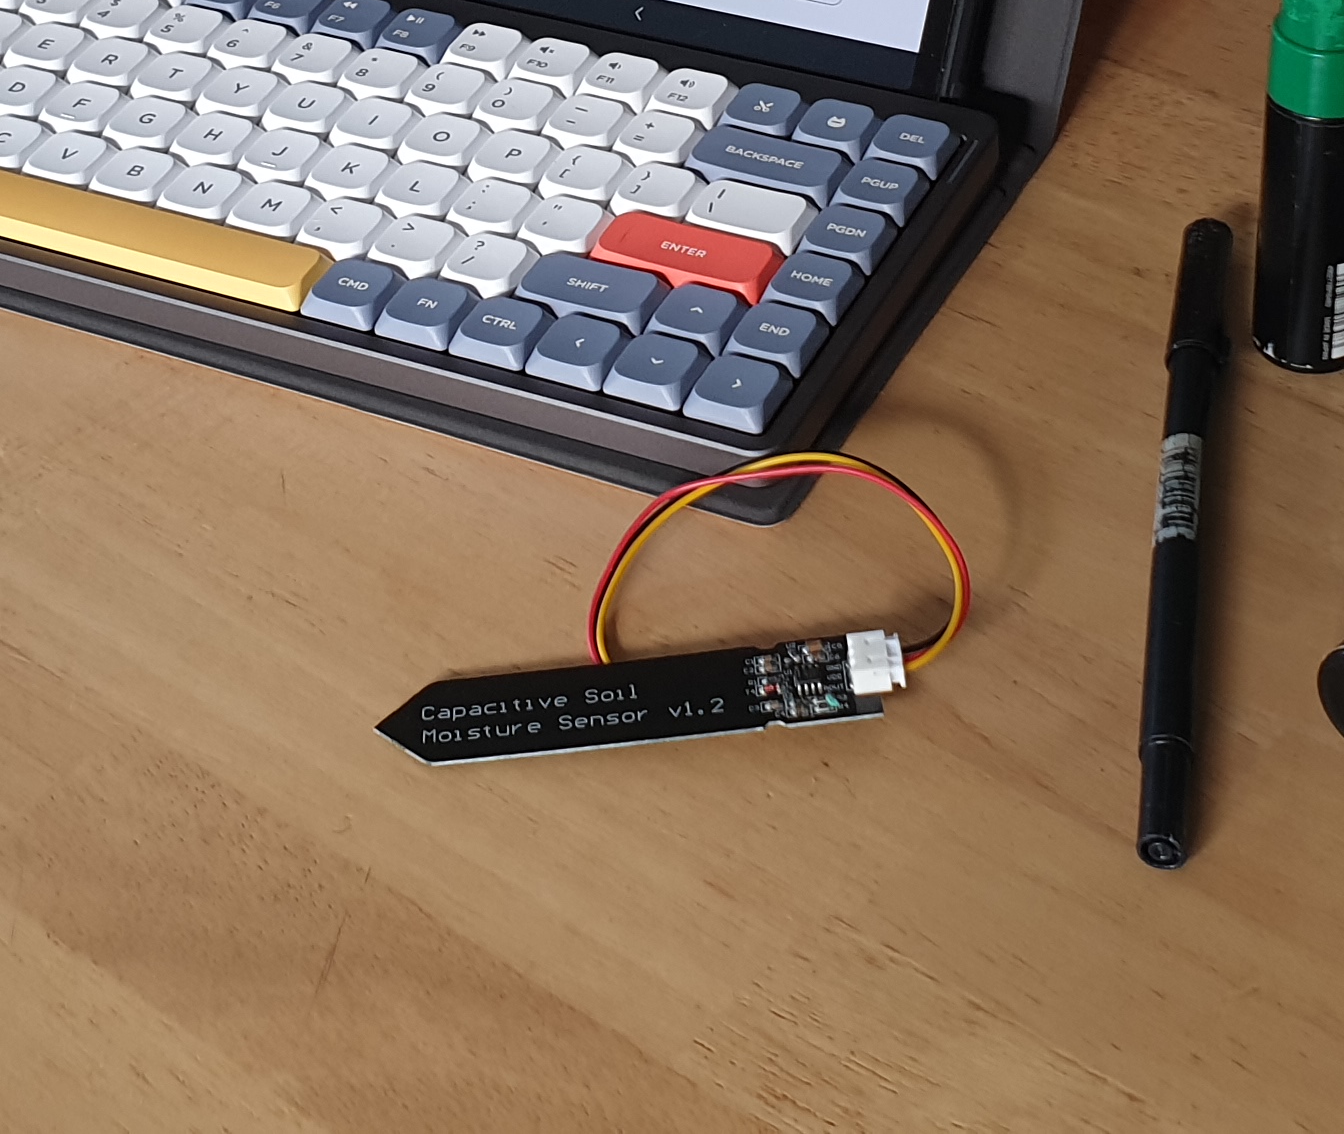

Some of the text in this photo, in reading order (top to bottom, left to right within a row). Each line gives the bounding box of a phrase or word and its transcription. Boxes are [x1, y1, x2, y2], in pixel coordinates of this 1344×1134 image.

[264, 1, 281, 9] F6
[173, 13, 185, 22] %
[160, 25, 174, 33] 5
[37, 39, 55, 49] E
[226, 40, 239, 48] 6
[101, 54, 118, 65] R
[291, 53, 304, 61] 7
[527, 59, 548, 68] F10
[169, 68, 183, 78] T
[355, 68, 369, 77] 8
[596, 75, 615, 84] F11
[8, 82, 26, 92] D
[234, 83, 249, 94] Y
[422, 84, 436, 92] 9
[72, 98, 91, 108] F
[667, 93, 688, 102] F12
[298, 98, 315, 109] U
[139, 113, 156, 124] G
[368, 115, 378, 125] I
[203, 129, 223, 141] H
[433, 131, 450, 142] O
[899, 133, 924, 144] DEL
[62, 148, 78, 159] V
[272, 147, 288, 156] J
[505, 148, 522, 158] P
[723, 143, 806, 171] BACKSPACE
[126, 165, 144, 176] B
[341, 162, 360, 174] K
[193, 181, 213, 194] N
[409, 181, 420, 193] L
[861, 177, 899, 189] PGUP
[261, 198, 282, 212] M
[827, 223, 866, 237] PGDN
[474, 240, 485, 250] ?
[661, 241, 706, 257] ENTER
[338, 277, 369, 290] CMD
[791, 270, 833, 286] HOME
[567, 278, 609, 292] SHIFT
[417, 298, 438, 308] FN
[482, 315, 516, 330] CTRL
[759, 323, 790, 336] END
[419, 684, 638, 723] Capacitive Soil
[421, 697, 725, 745] Moisture Sensor v1.2
